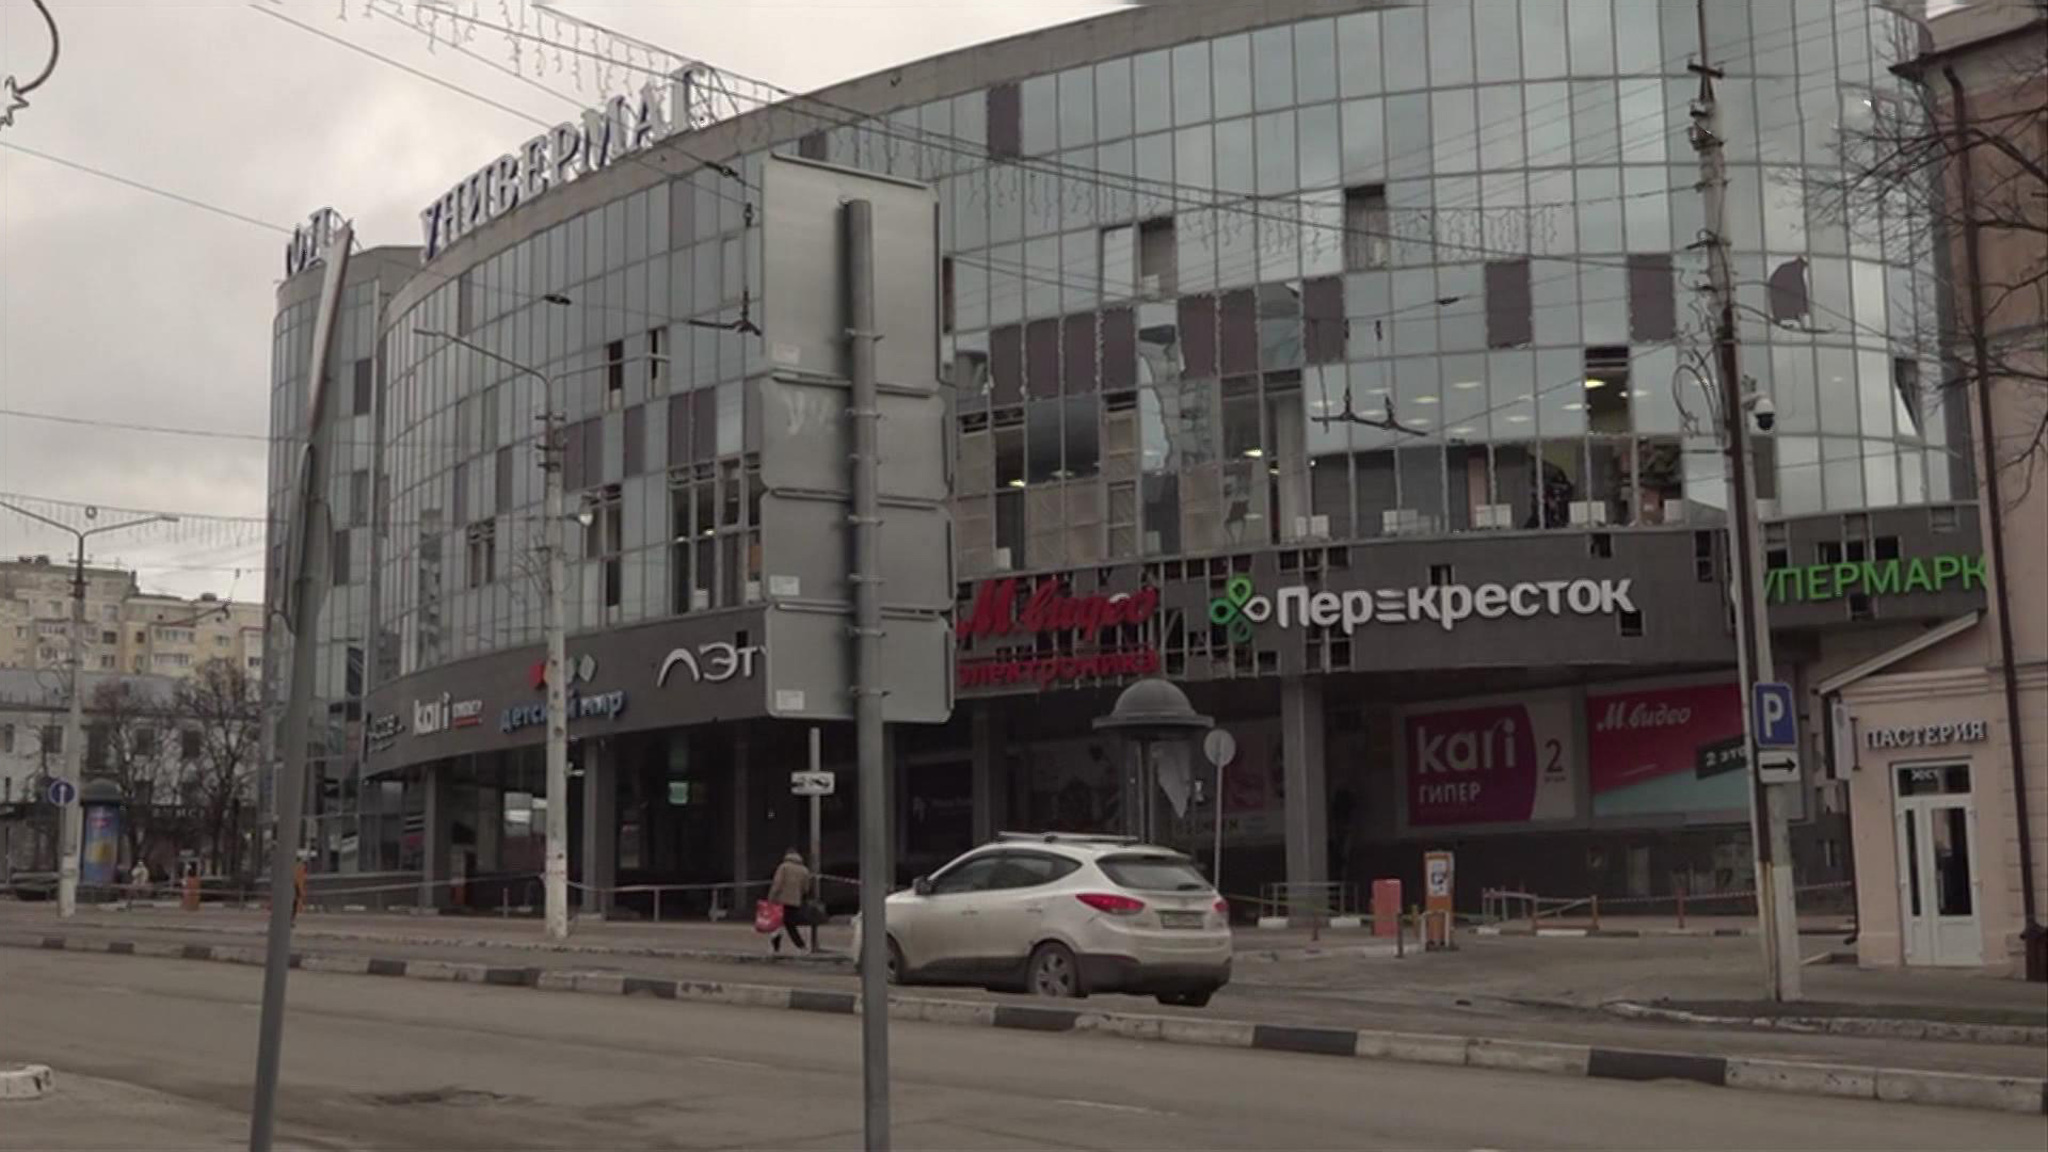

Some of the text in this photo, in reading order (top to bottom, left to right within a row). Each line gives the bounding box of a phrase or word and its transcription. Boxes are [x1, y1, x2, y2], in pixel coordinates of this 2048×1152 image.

[420, 62, 712, 264] УНИВЕРМАГ
[1277, 579, 1636, 634] Перекресток
[657, 642, 768, 688] ЛЭТ
[413, 692, 451, 735] kari
[580, 690, 627, 720] мир
[1416, 718, 1516, 774] kari
[1866, 720, 1988, 750] ПАСТЕРИЯ
[1545, 738, 1563, 773] 2
[1705, 751, 1717, 767] 2
[1418, 782, 1481, 805] ГИПЕР
